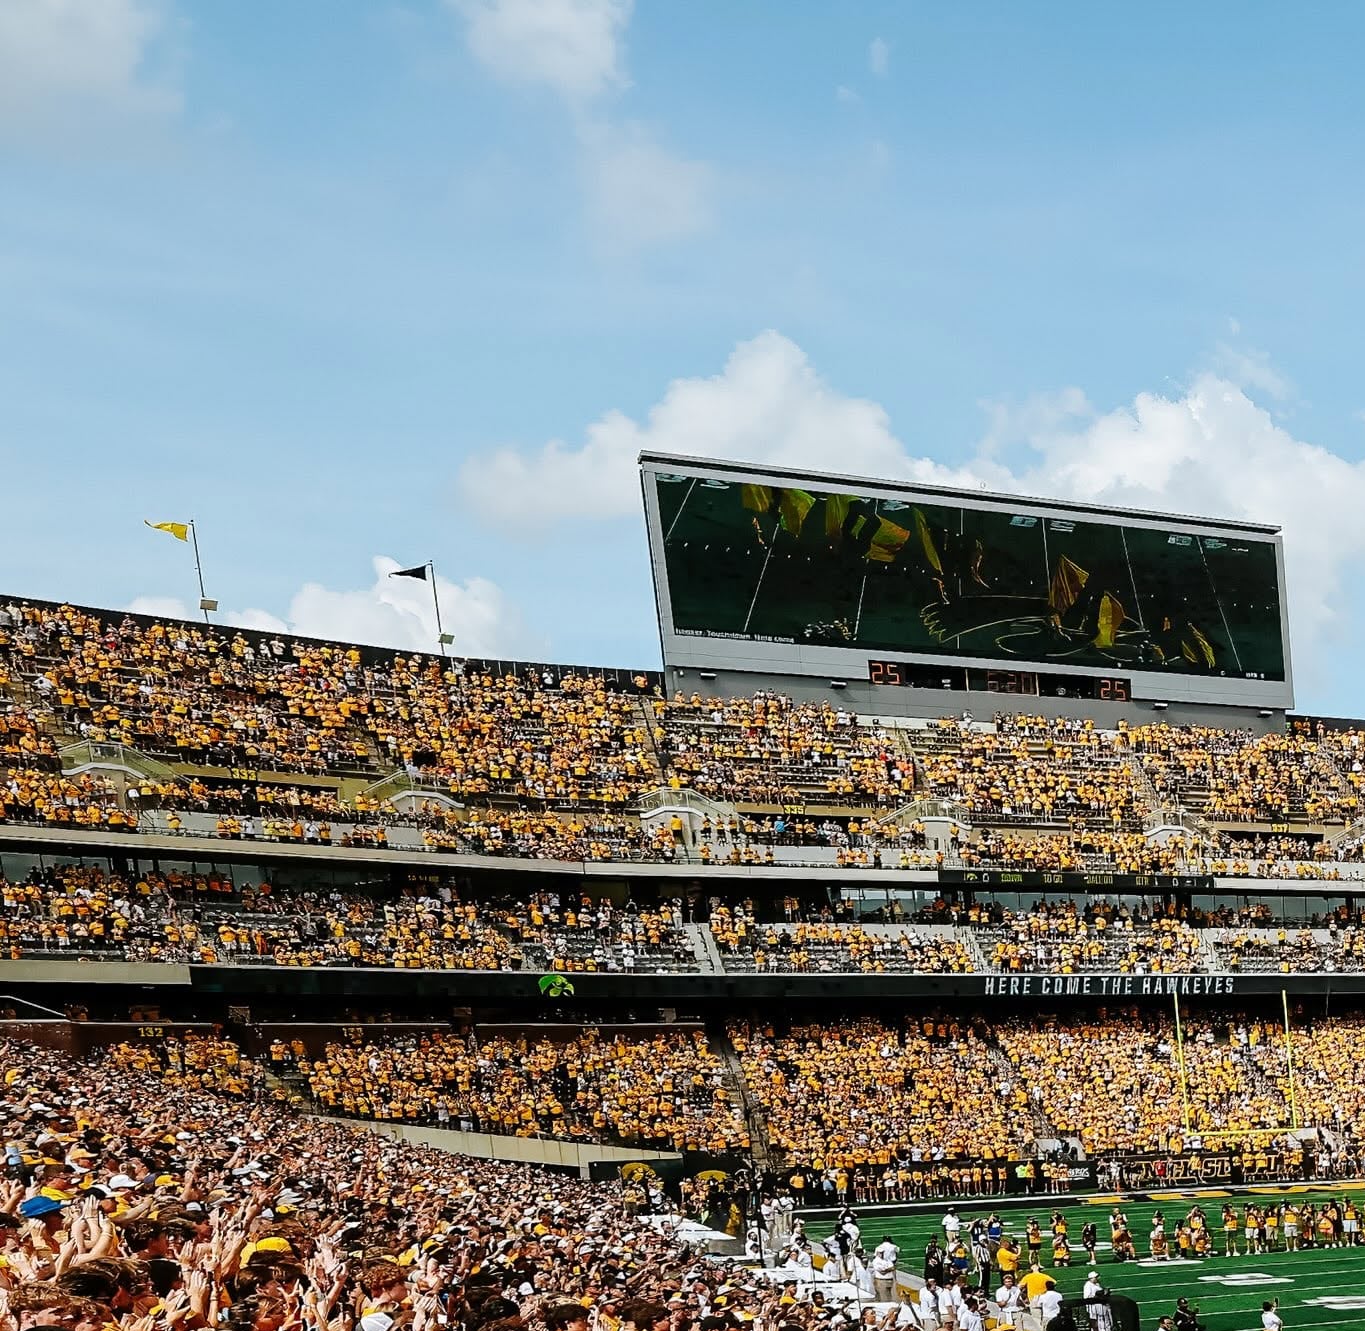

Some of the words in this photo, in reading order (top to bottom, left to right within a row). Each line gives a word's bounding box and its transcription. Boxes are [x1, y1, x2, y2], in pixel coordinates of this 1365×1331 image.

[871, 662, 900, 685] 25
[985, 976, 1031, 995] HERE
[1042, 976, 1091, 995] COME
[1100, 976, 1133, 995] THE
[1143, 976, 1235, 995] HAWKEYES
